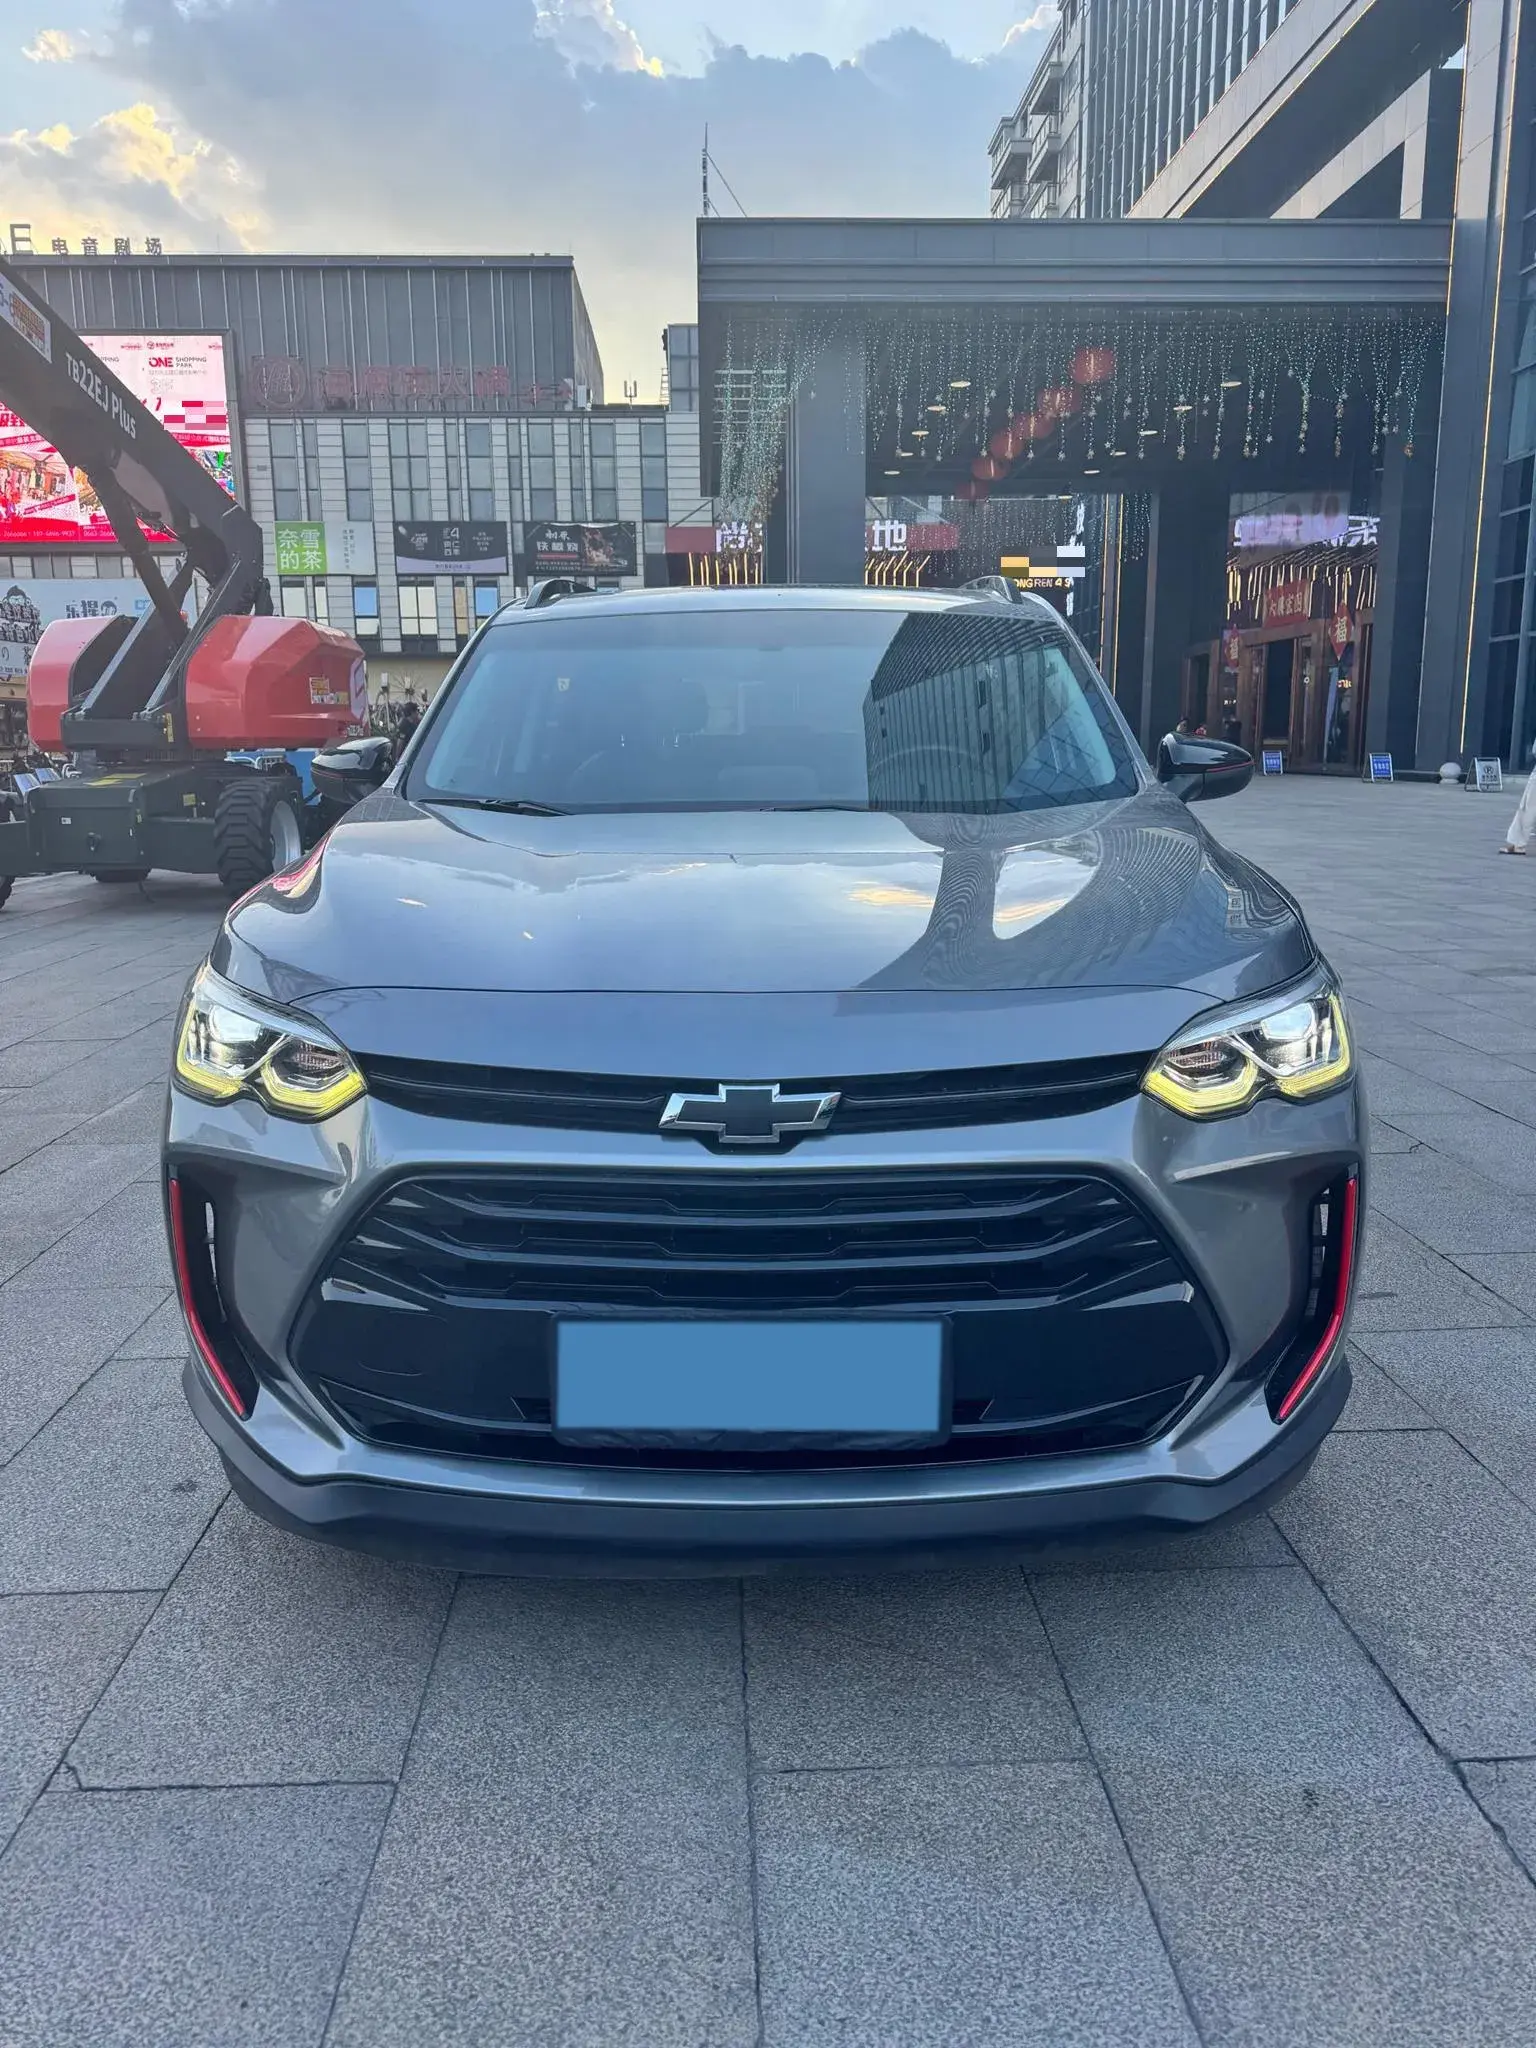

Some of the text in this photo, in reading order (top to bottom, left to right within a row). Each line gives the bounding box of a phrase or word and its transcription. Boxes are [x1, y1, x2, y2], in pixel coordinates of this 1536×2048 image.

[51, 236, 163, 257] 电音剧场
[148, 356, 174, 368] ONE
[66, 351, 136, 440] TB22EJ Plus
[278, 529, 321, 549] 奈雪
[871, 519, 907, 551] 地
[279, 550, 323, 571] 的茶
